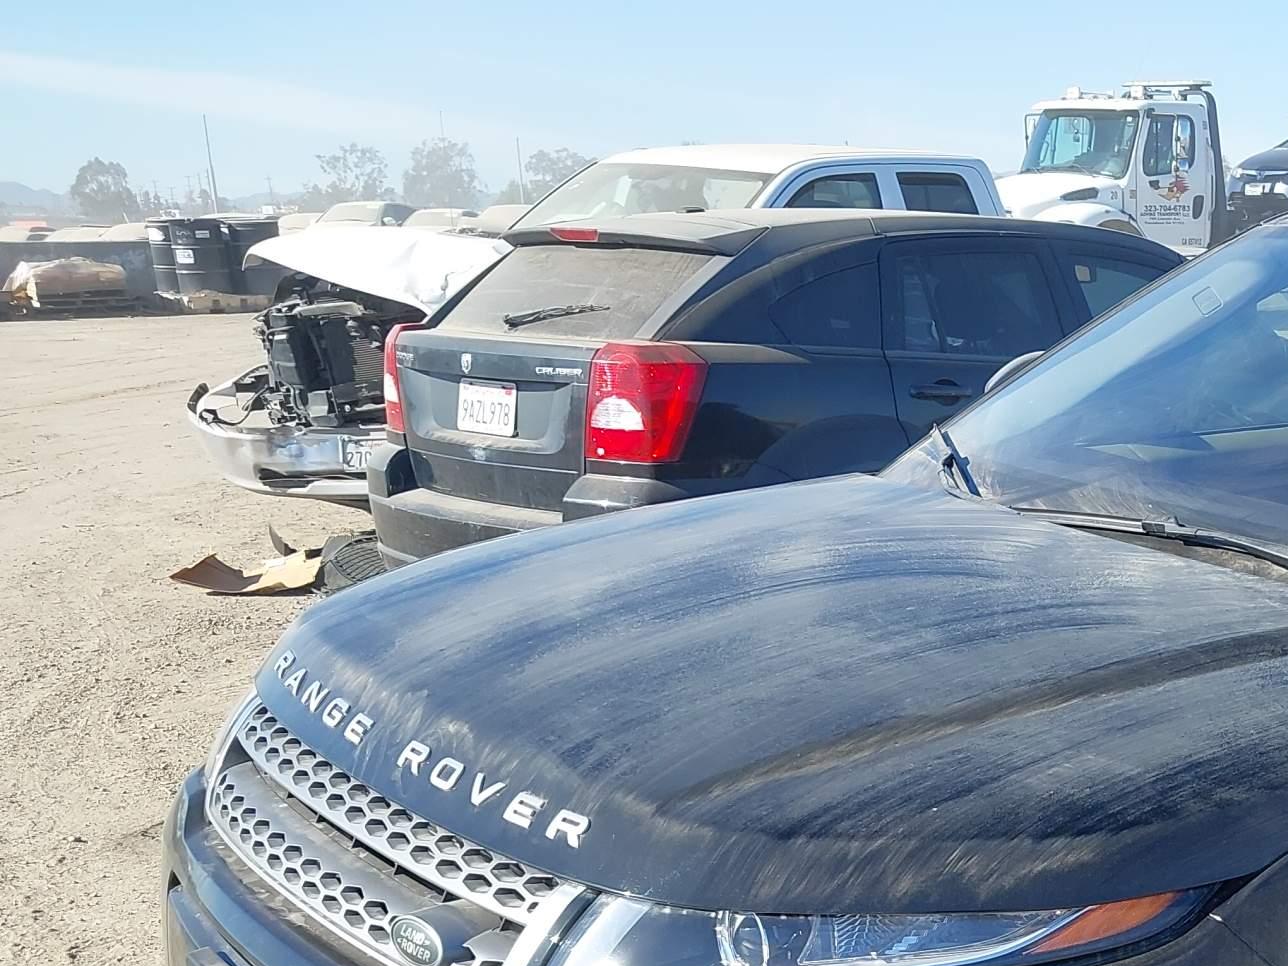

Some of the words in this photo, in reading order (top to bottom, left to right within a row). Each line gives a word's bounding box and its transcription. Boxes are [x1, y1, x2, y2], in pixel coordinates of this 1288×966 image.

[535, 366, 583, 377] CALIBER
[462, 399, 510, 427] 9AZL978
[273, 648, 376, 745] RANGE
[396, 739, 592, 849] ROVER
[400, 924, 425, 945] LAND
[400, 938, 431, 962] ROVER
